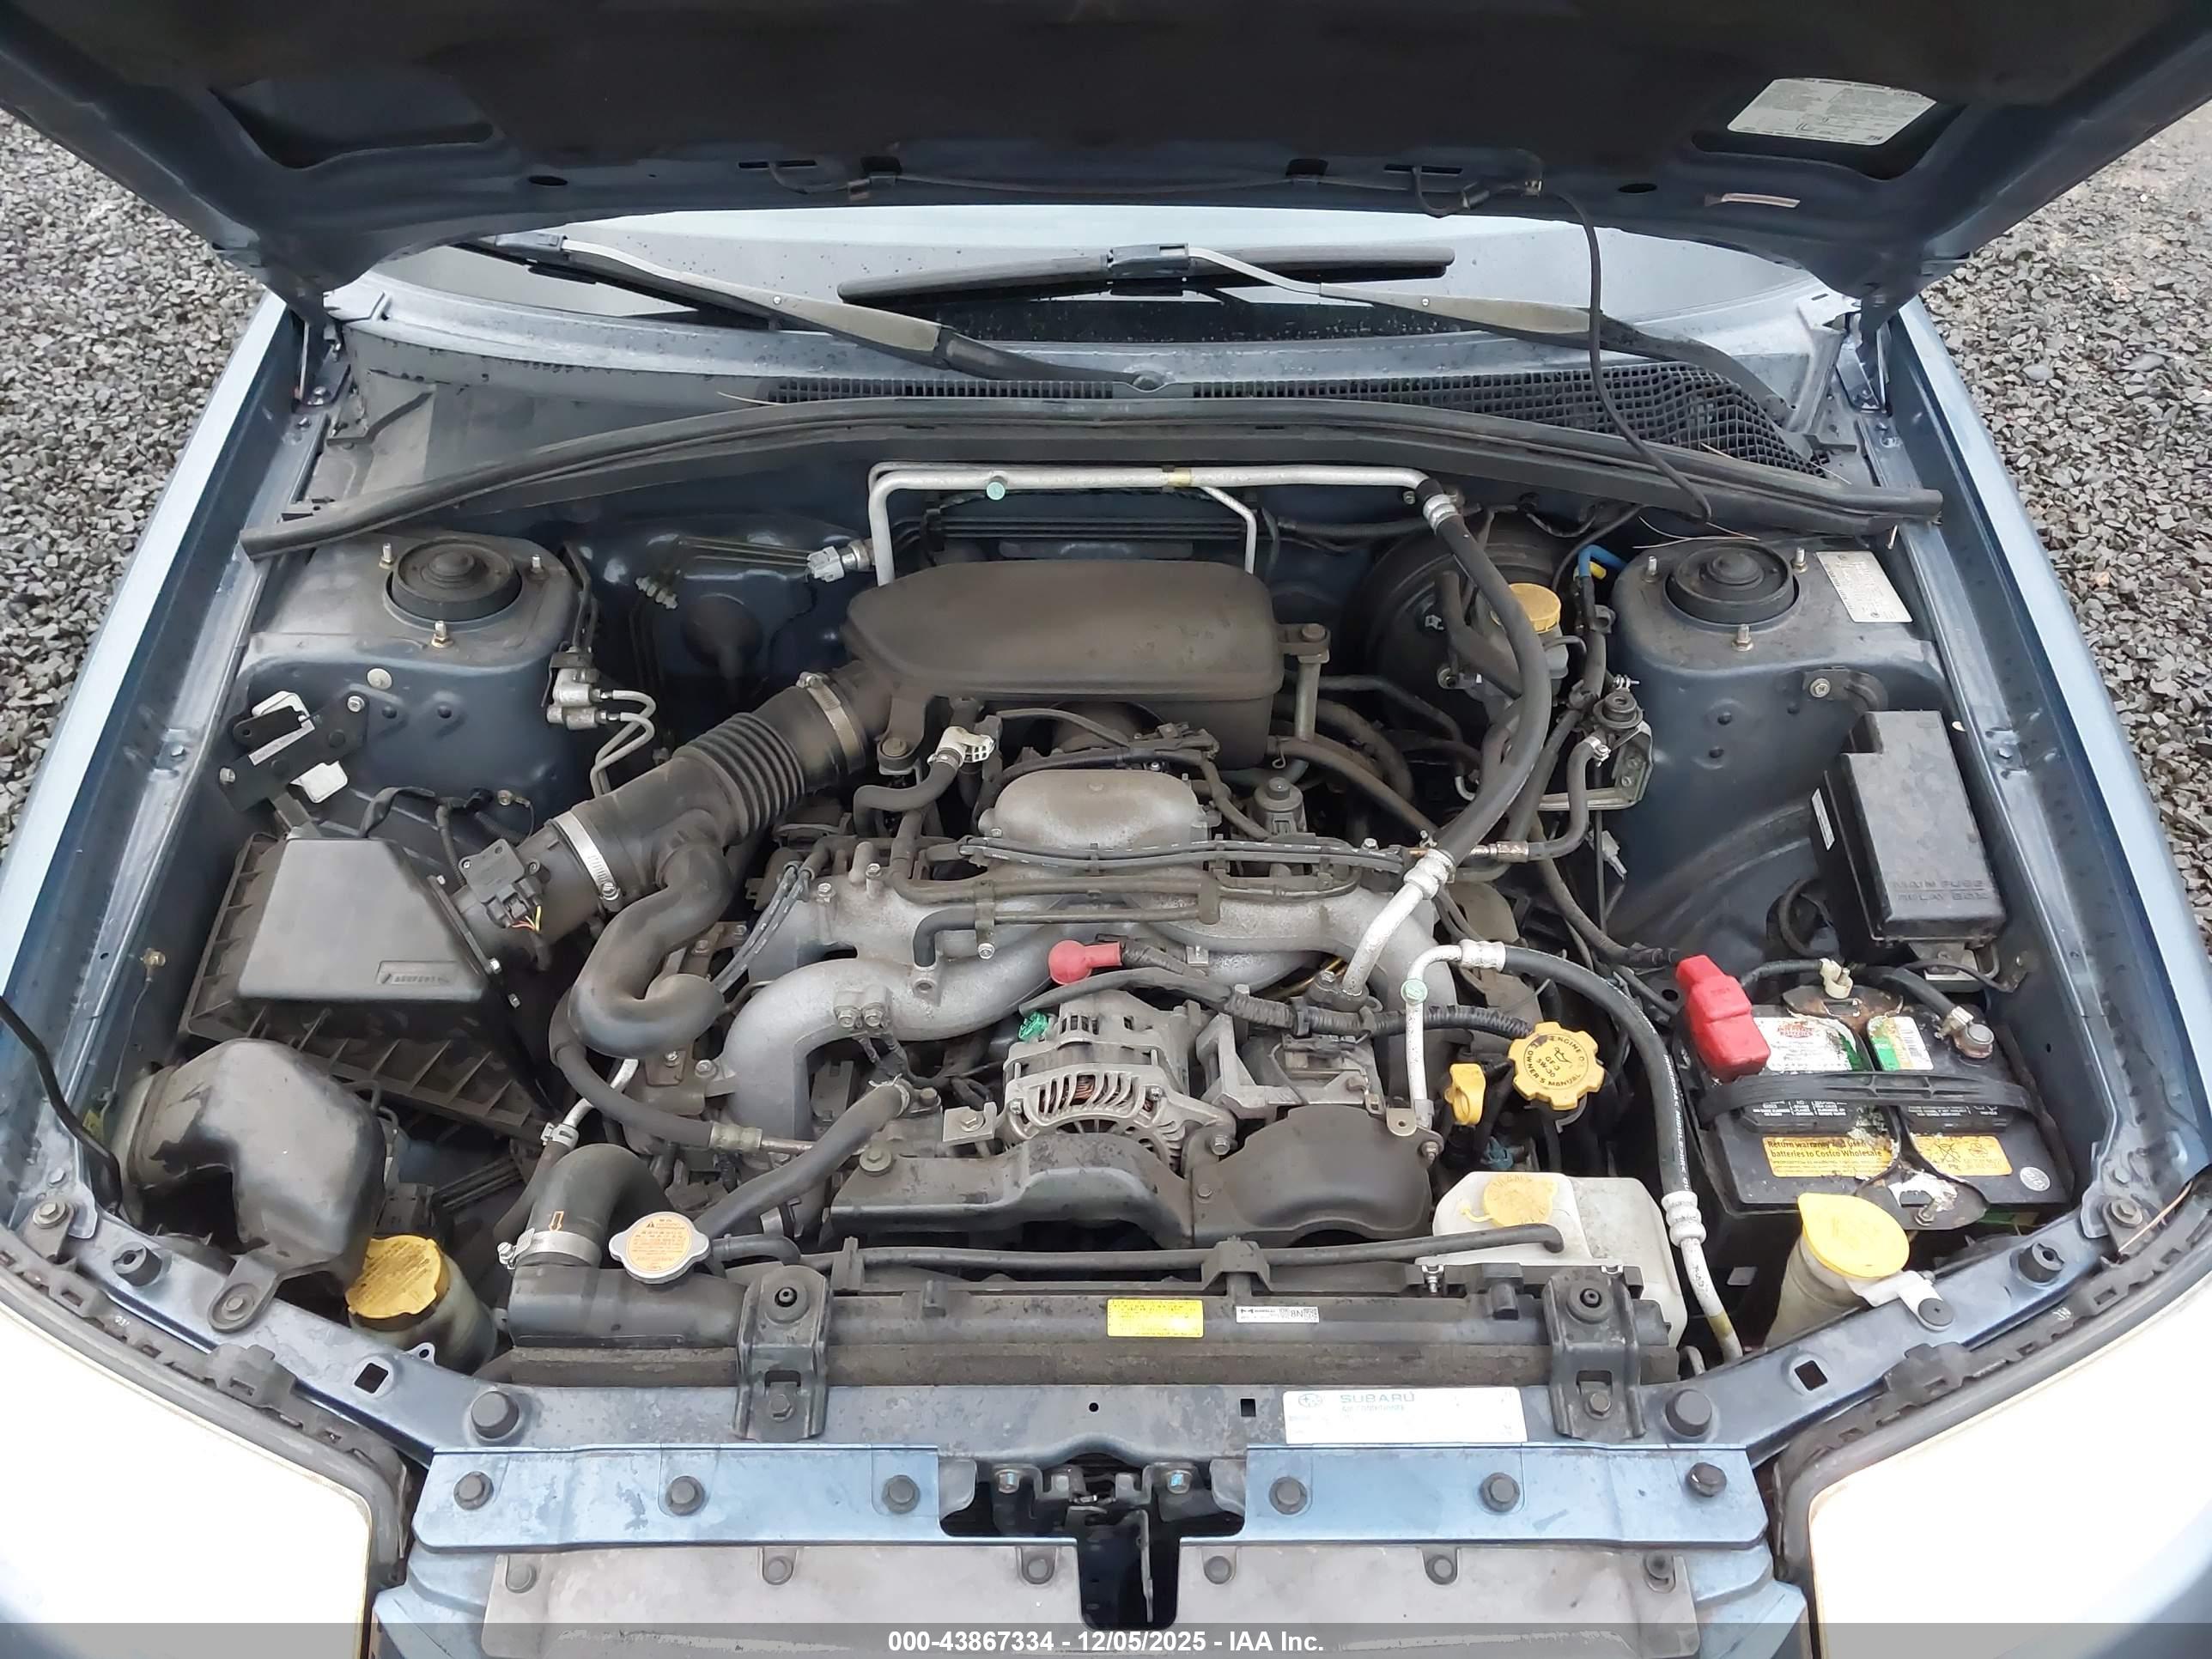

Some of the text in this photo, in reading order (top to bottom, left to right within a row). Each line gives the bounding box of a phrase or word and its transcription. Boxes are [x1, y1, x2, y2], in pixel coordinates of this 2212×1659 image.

[1548, 1036, 1582, 1053] ENGINE
[1547, 1074, 1581, 1086] MANUAL
[1815, 1149, 1841, 1158] Costco
[1842, 1149, 1883, 1158] Wholesale
[1340, 1393, 1415, 1403] SUBARU
